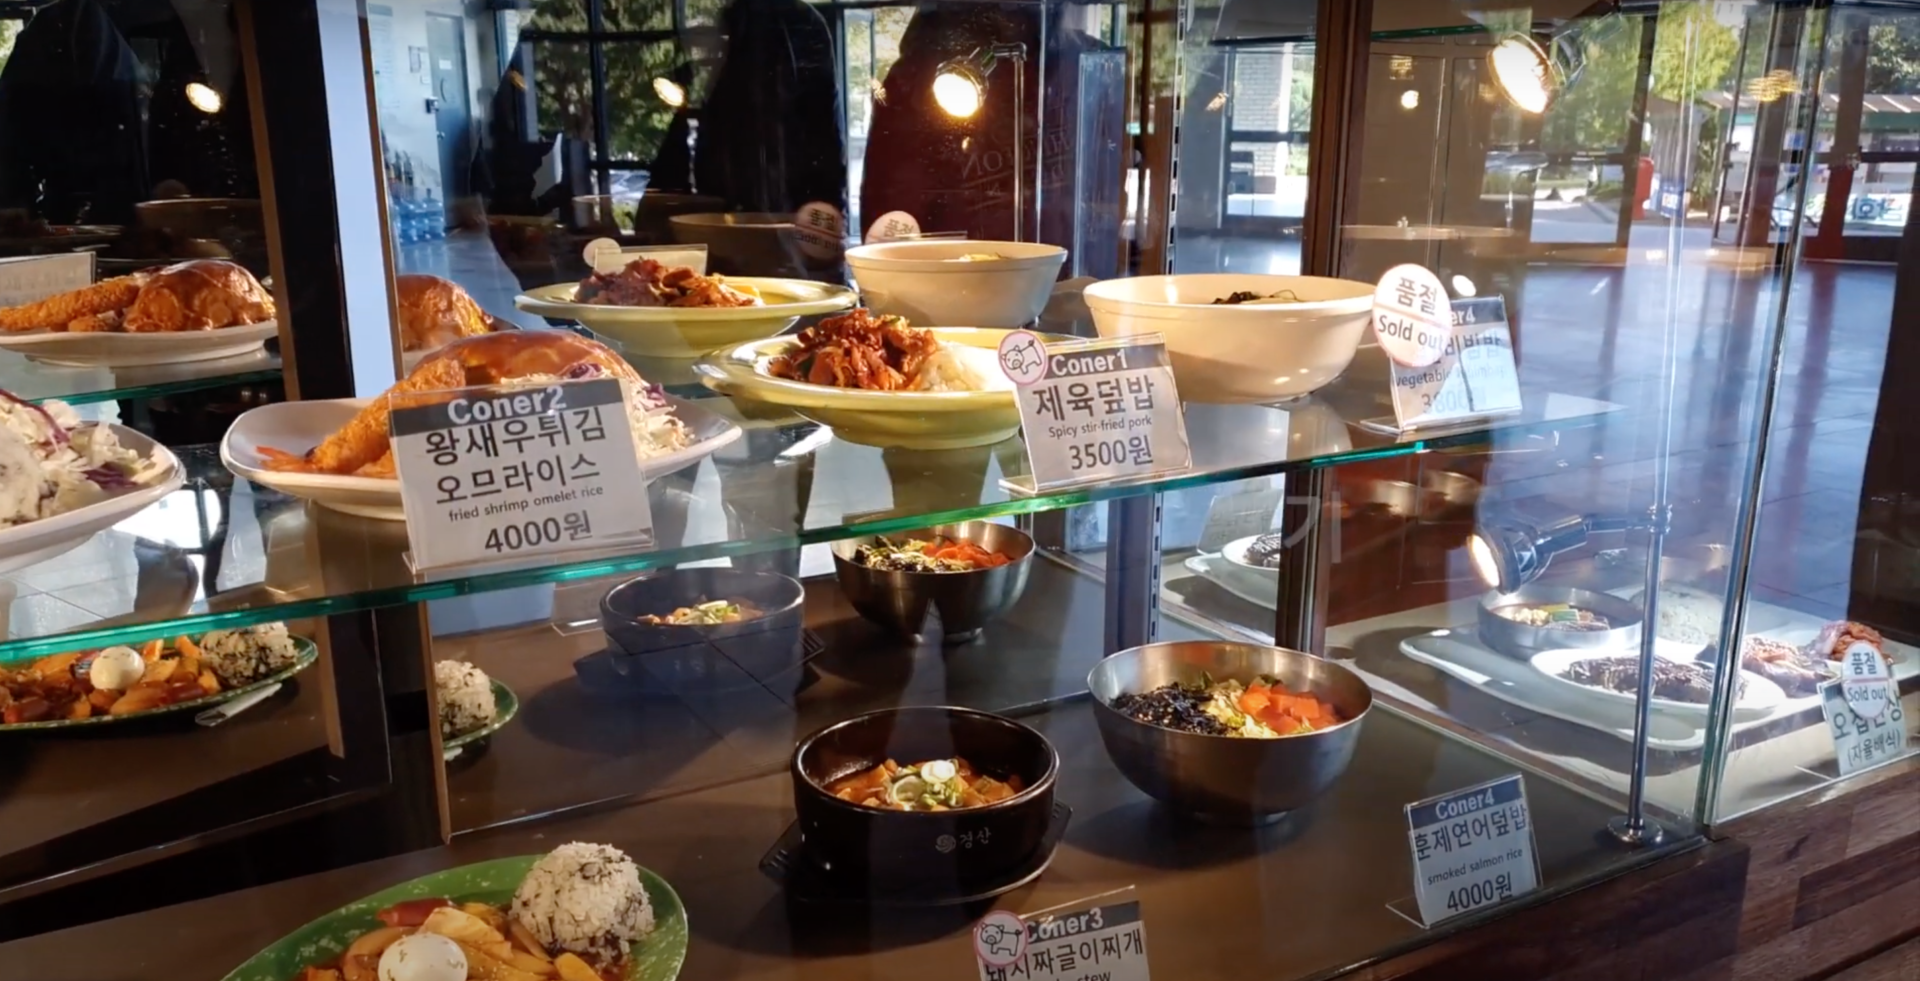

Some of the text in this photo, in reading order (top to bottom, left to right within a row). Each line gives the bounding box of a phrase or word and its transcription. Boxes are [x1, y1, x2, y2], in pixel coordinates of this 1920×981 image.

[1395, 277, 1437, 316] 품절
[1378, 315, 1445, 350] Sold out
[1051, 348, 1128, 376] Coner1
[447, 385, 567, 424] Coner2
[1032, 375, 1155, 421] 제육덮밥
[426, 406, 606, 466] 왕새우튀김
[1049, 415, 1152, 440] Spicy stir-fried pork
[1069, 435, 1153, 470] 3500원
[436, 454, 600, 504] 오므라이스
[449, 485, 604, 522] fried shrimp omelet rice
[484, 510, 593, 553] 4000원
[1852, 651, 1877, 675] 품절
[1847, 685, 1888, 702] Sold out
[1435, 788, 1495, 819] Coner4
[1415, 802, 1527, 861] 훈제연어덮밥
[1427, 848, 1523, 885] smoked salmon rice
[1447, 871, 1513, 912] 4000원
